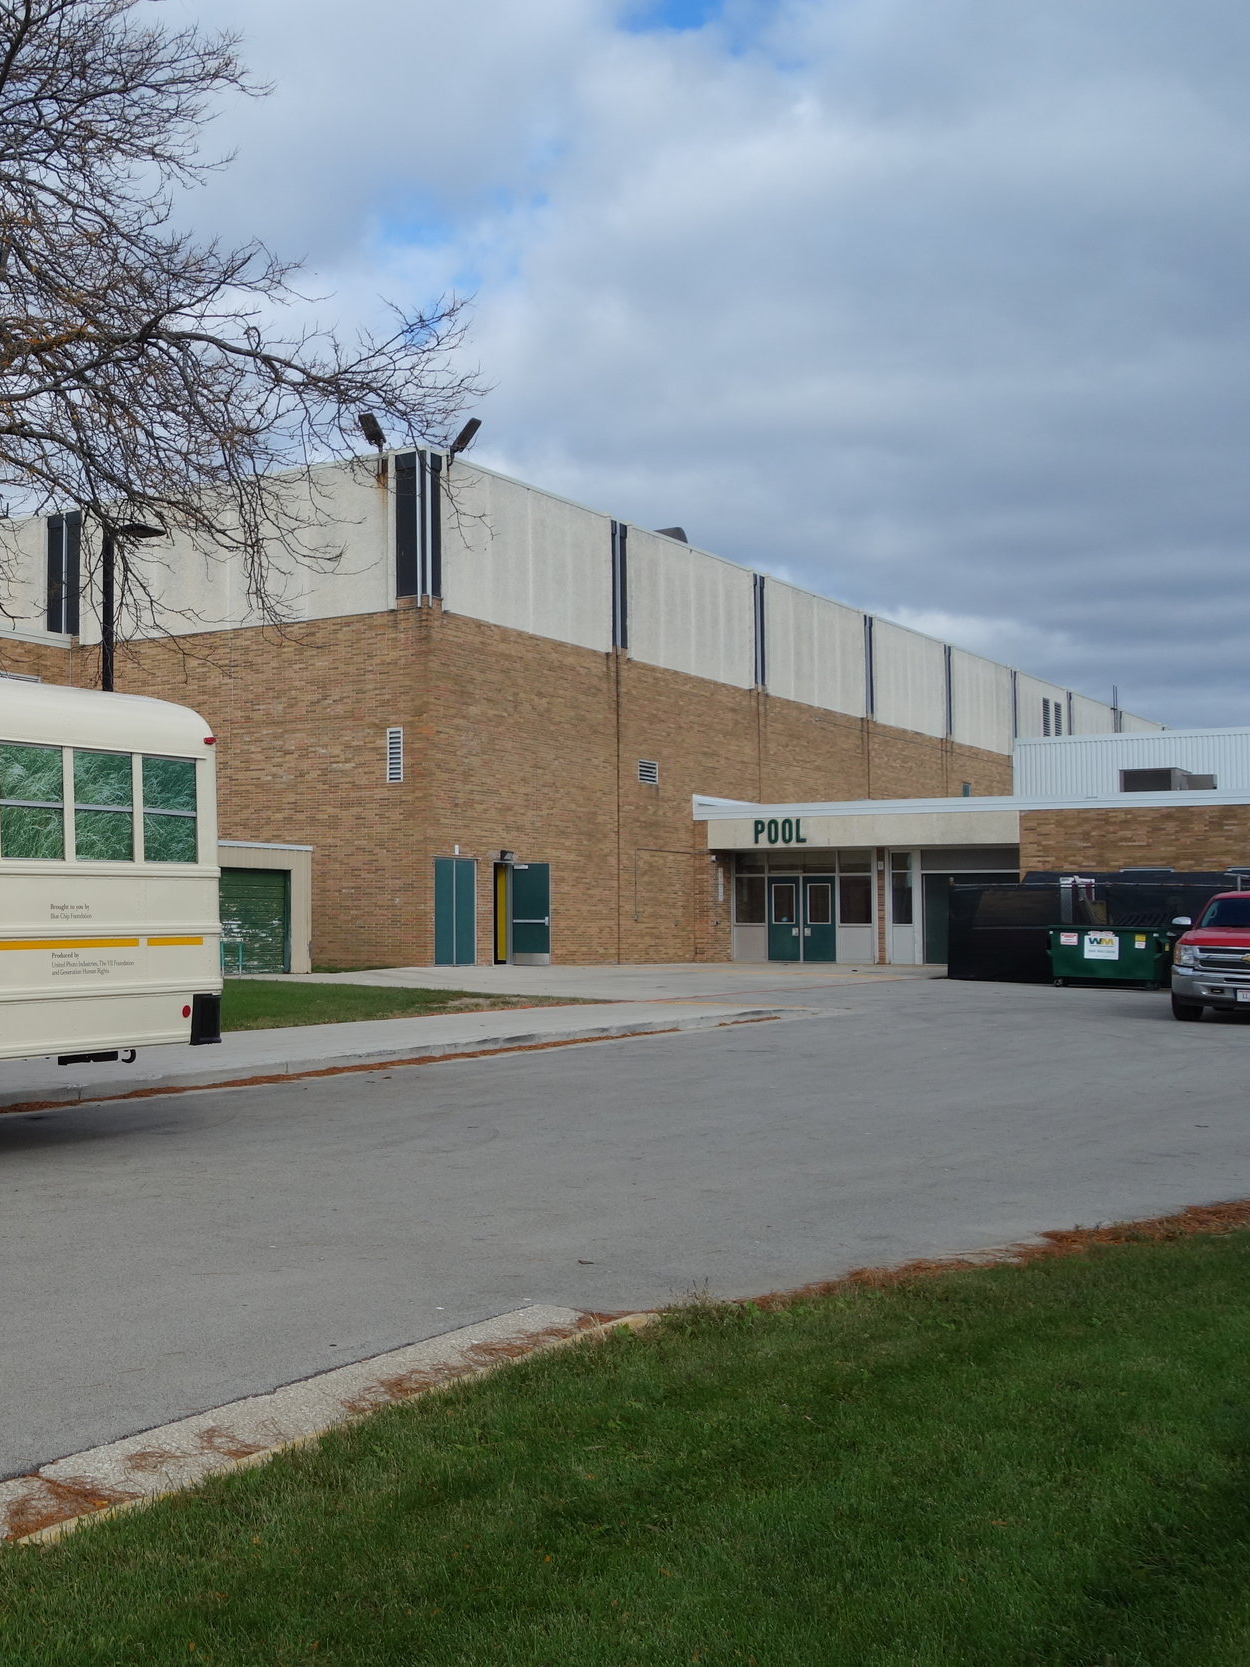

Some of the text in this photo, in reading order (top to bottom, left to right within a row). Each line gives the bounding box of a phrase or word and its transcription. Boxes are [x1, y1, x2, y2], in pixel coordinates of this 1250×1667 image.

[754, 818, 807, 844] POOL
[50, 903, 69, 911] Brought
[85, 903, 90, 911] by
[1089, 937, 1114, 945] WM
[74, 952, 80, 960] by
